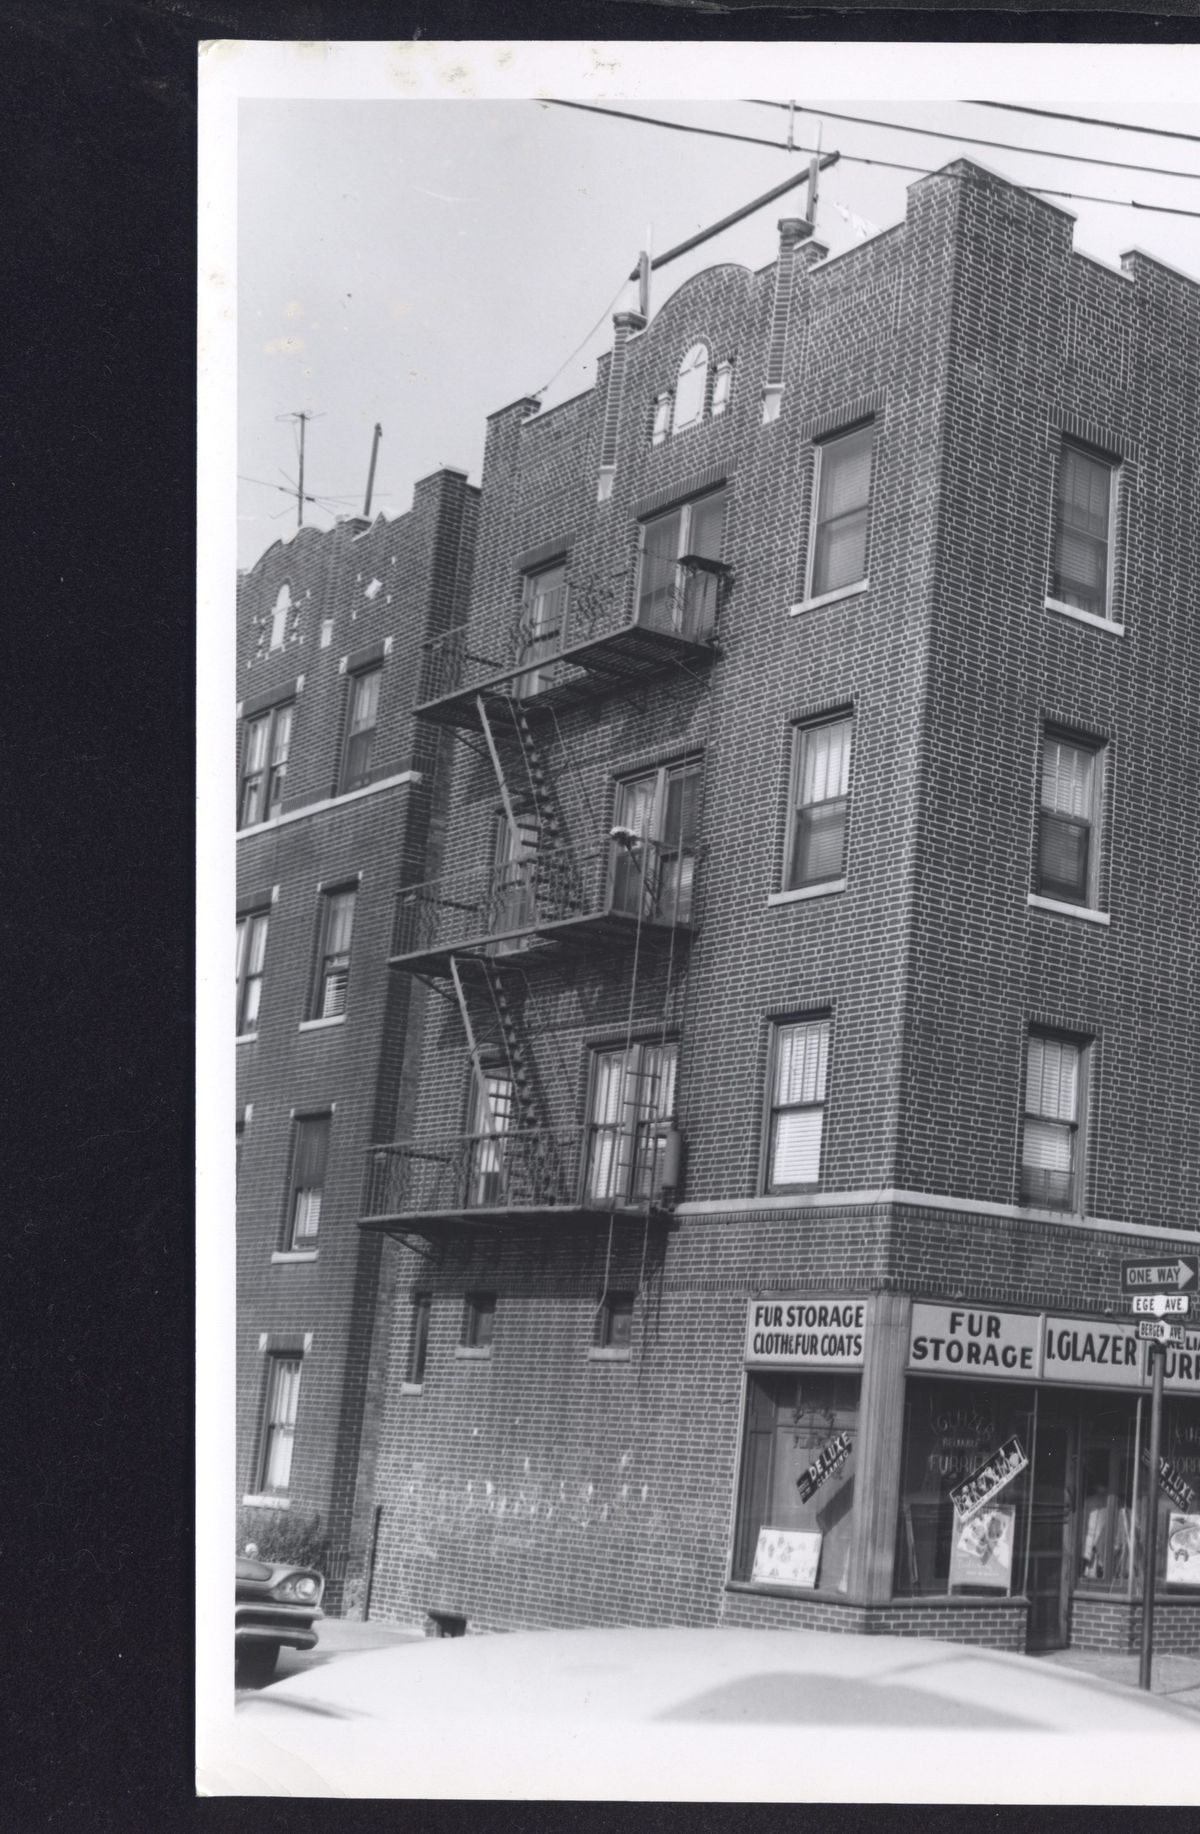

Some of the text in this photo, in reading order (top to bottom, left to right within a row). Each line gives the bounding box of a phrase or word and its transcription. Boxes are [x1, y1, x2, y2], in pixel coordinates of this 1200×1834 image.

[1129, 1267, 1181, 1284] ONE WAY
[755, 1305, 864, 1328] FUR STORAGE
[1136, 1300, 1154, 1311] EGE
[950, 1312, 1000, 1339] FUR
[1141, 1323, 1165, 1337] BERGEN
[821, 1333, 862, 1356] COATS
[912, 1337, 1033, 1369] STORAGE
